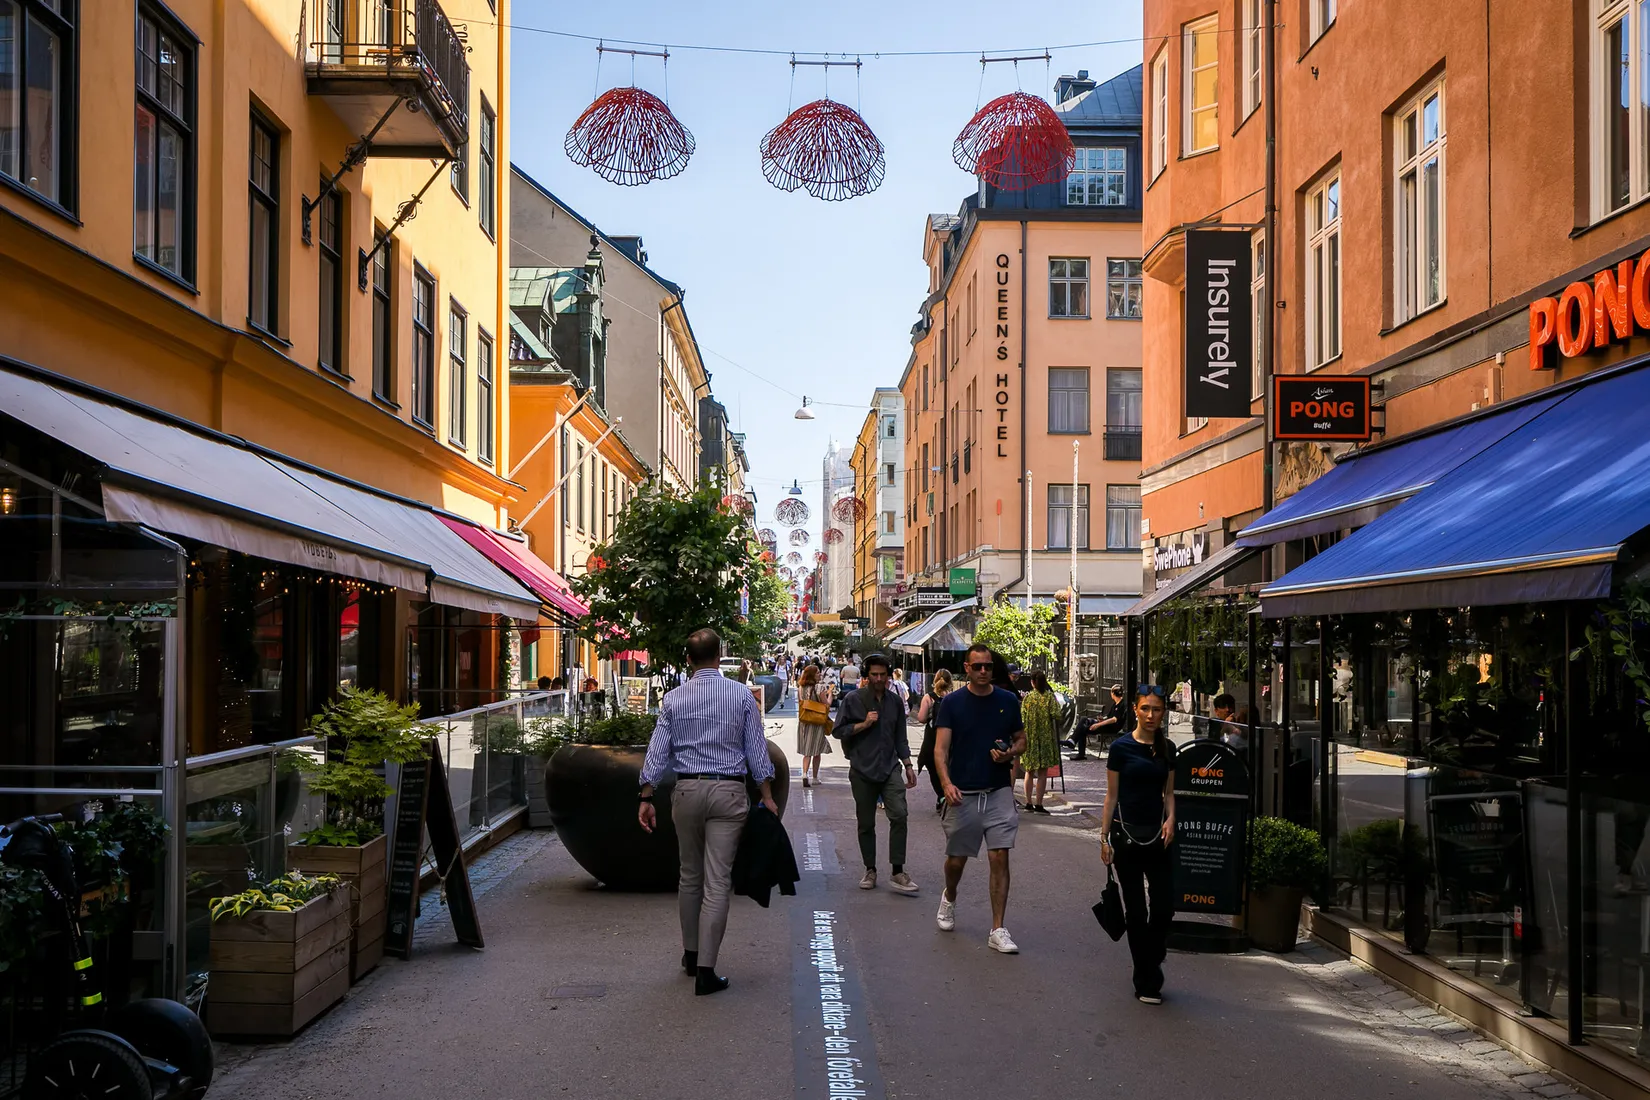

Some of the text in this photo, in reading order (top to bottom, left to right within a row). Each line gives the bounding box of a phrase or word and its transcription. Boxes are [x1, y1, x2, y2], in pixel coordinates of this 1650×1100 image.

[1200, 259, 1238, 389] Insurely
[996, 373, 1009, 458] HOTEL
[1290, 401, 1355, 418] PONG
[1313, 422, 1332, 430] Buffé
[1154, 543, 1191, 571] SwePhone
[1191, 767, 1224, 777] PONG
[1191, 778, 1223, 786] GRUPPEN
[1178, 821, 1234, 835] PONG BUFFÉ
[1183, 893, 1215, 904] PONG
[79, 973, 88, 981] 2
[819, 973, 845, 982] att
[820, 984, 843, 1000] vara
